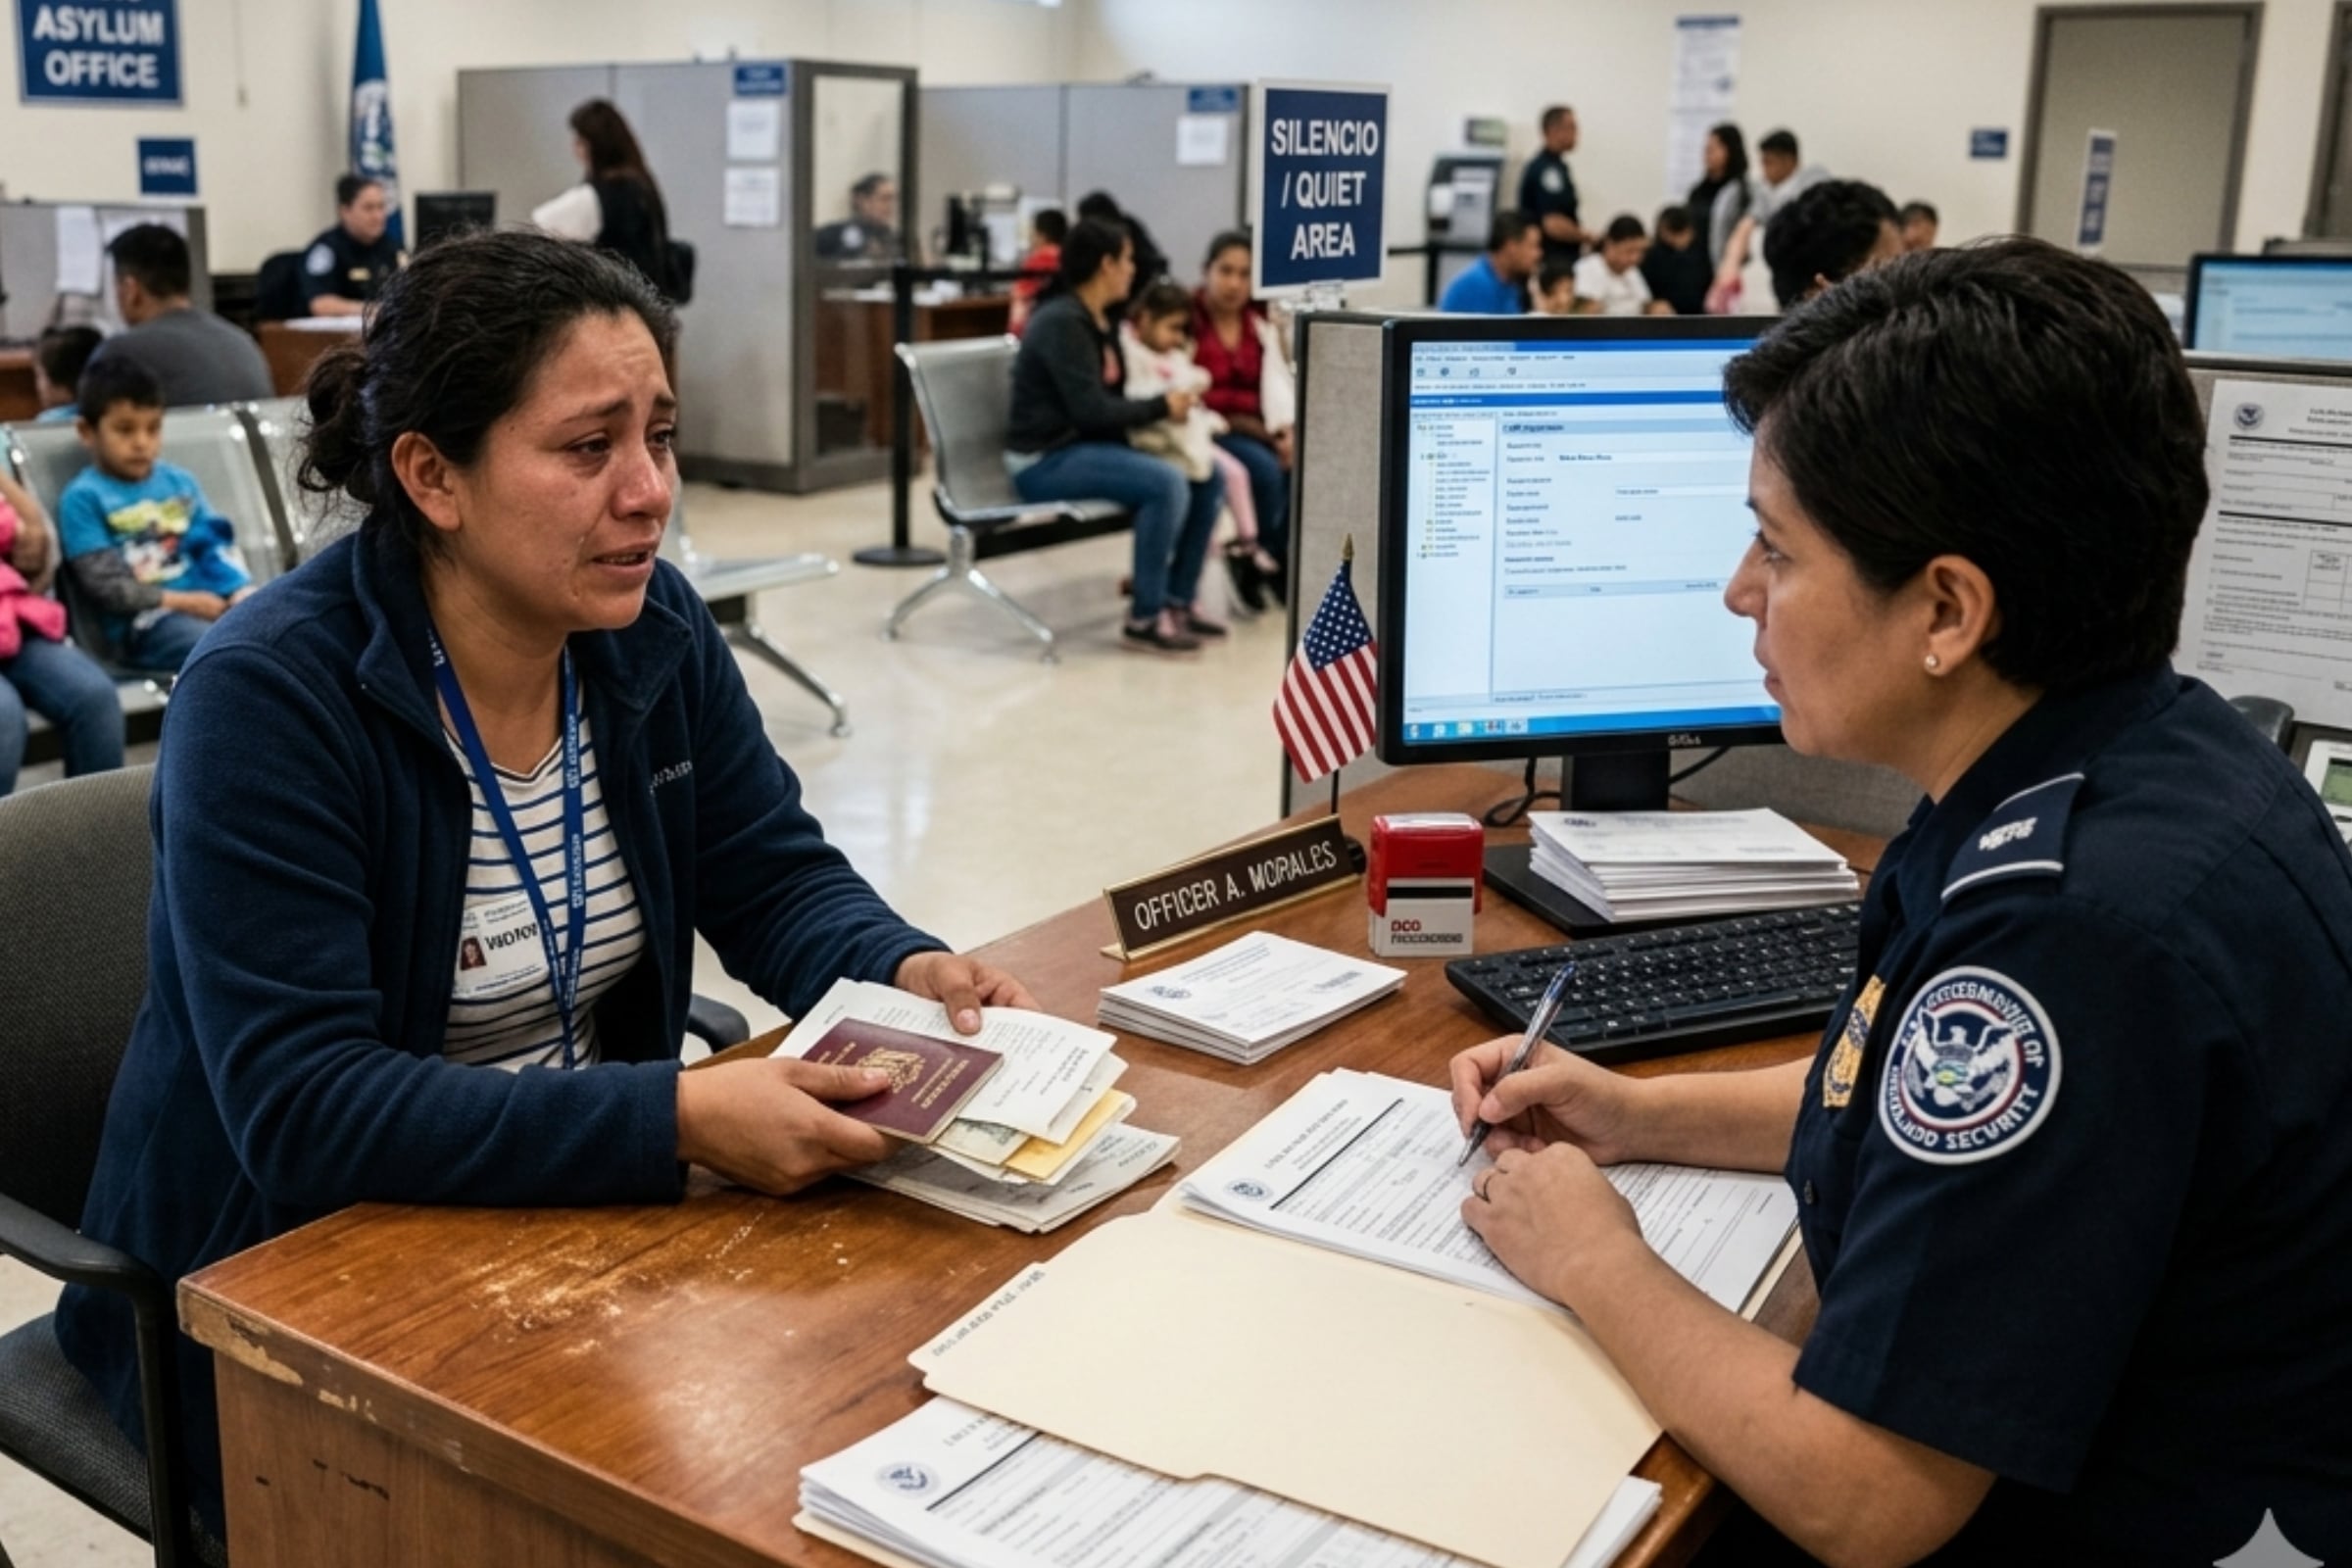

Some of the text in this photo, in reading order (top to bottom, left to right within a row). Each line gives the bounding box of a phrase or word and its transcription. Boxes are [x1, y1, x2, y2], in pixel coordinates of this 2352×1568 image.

[32, 5, 165, 45] ASYLUM
[44, 49, 160, 88] OFFICE
[1271, 118, 1379, 156] SILENCIO
[1281, 171, 1367, 209] / QUIET
[1290, 221, 1356, 260] AREA
[1134, 840, 1337, 930] OFFICER A. MORALES
